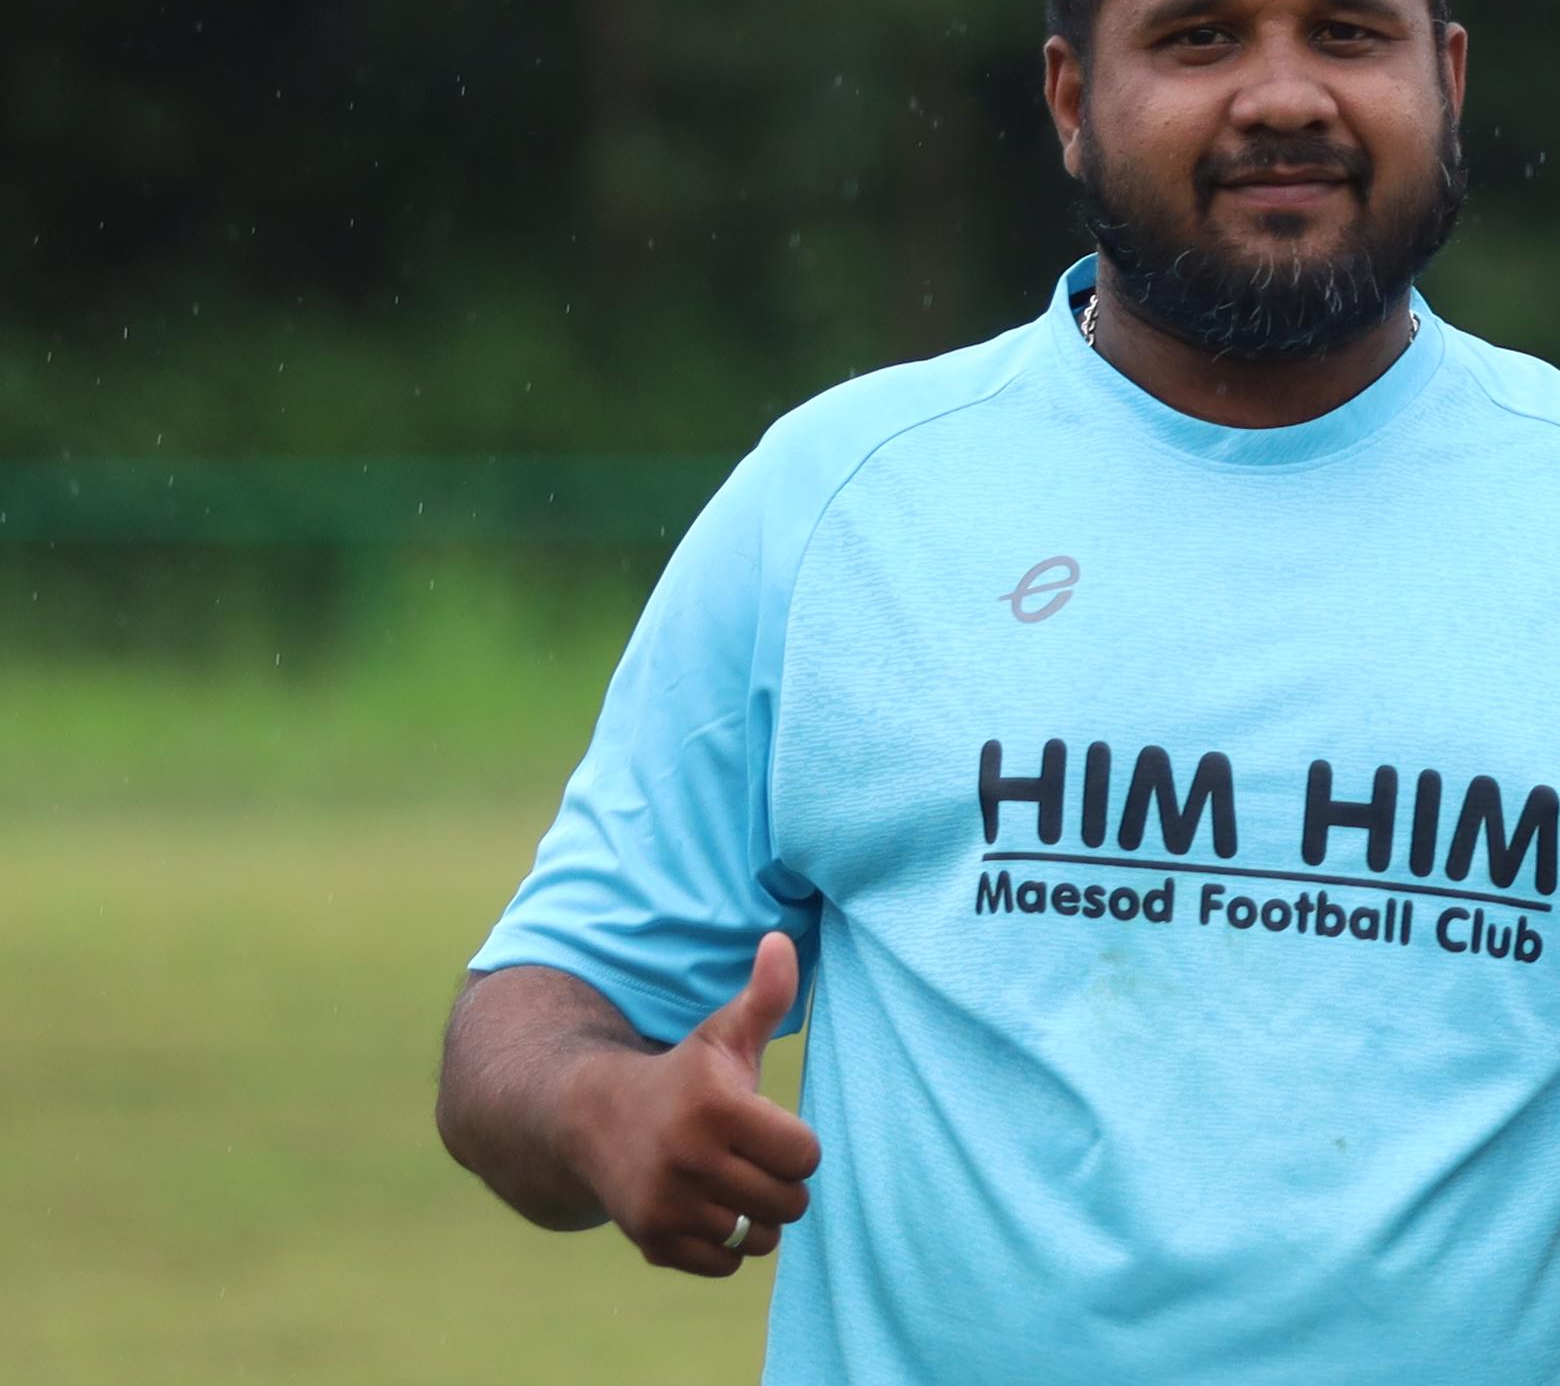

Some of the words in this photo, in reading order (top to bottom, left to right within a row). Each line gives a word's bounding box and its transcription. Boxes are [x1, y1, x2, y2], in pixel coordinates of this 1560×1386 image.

[978, 738, 1238, 859] HIM
[1301, 760, 1560, 896] HIM
[975, 871, 1175, 924] Maesod
[1200, 883, 1413, 945] Football
[1436, 907, 1543, 963] Club
